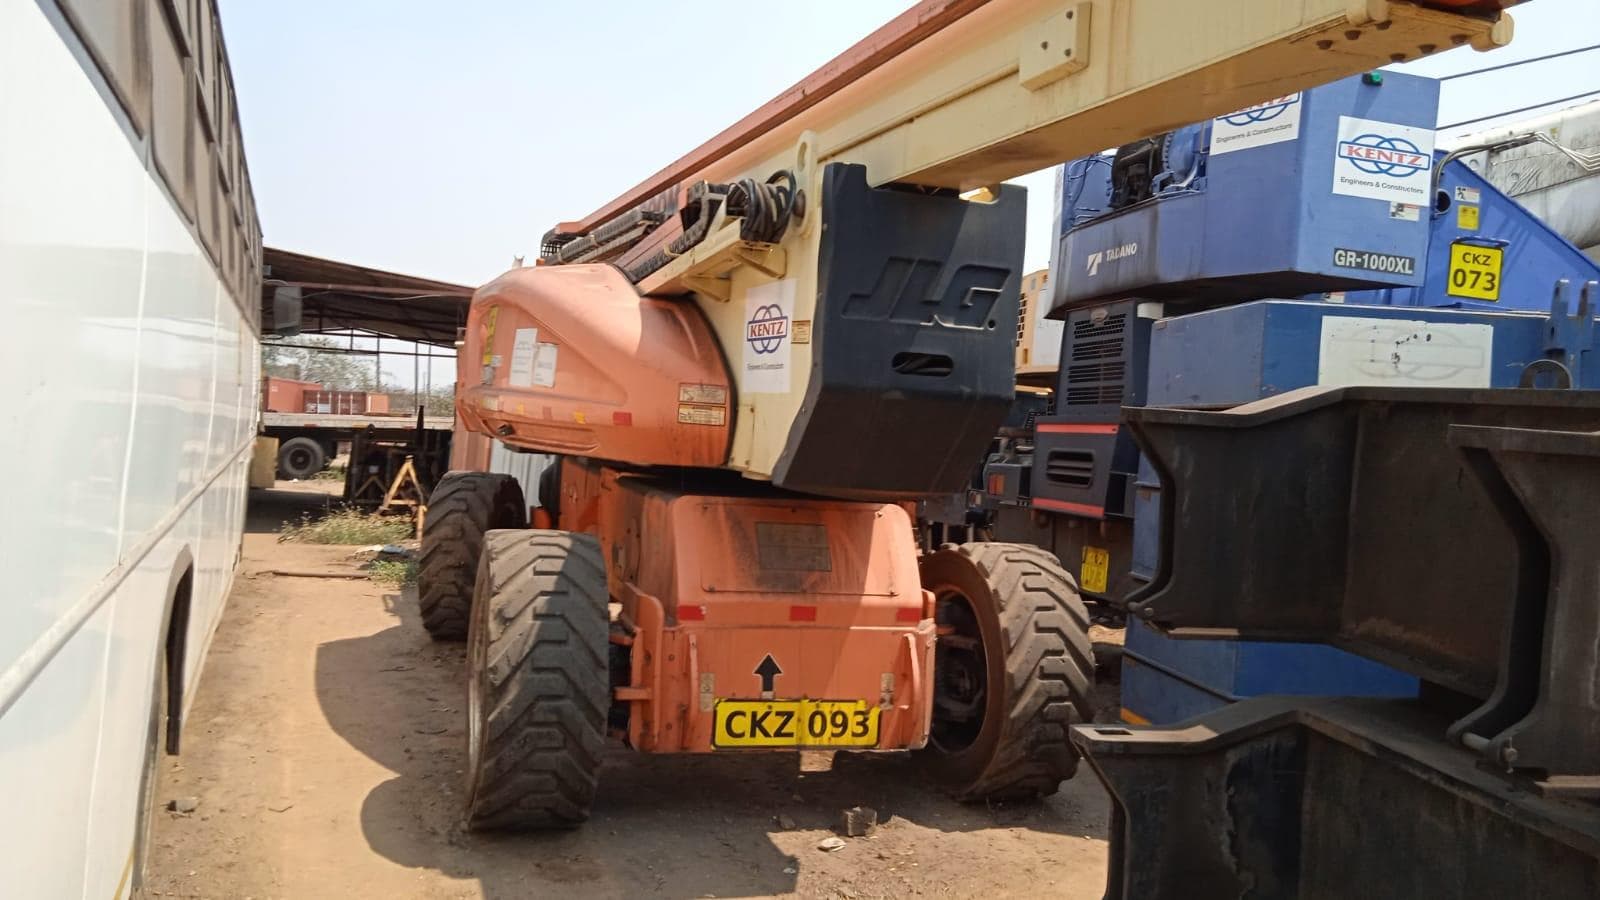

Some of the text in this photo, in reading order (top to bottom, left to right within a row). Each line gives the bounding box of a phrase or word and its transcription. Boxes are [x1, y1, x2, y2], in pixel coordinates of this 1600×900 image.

[1347, 146, 1423, 167] KENTZ
[1340, 176, 1374, 189] Engineers
[1381, 182, 1424, 195] Constructors
[1106, 242, 1138, 261] TADANO
[1334, 249, 1414, 275] GR-1000XL
[1462, 252, 1492, 267] CKZ
[1453, 269, 1496, 293] 073
[841, 256, 1012, 331] JLG
[750, 321, 784, 338] KENTZ
[725, 710, 871, 738] CKZ 093
